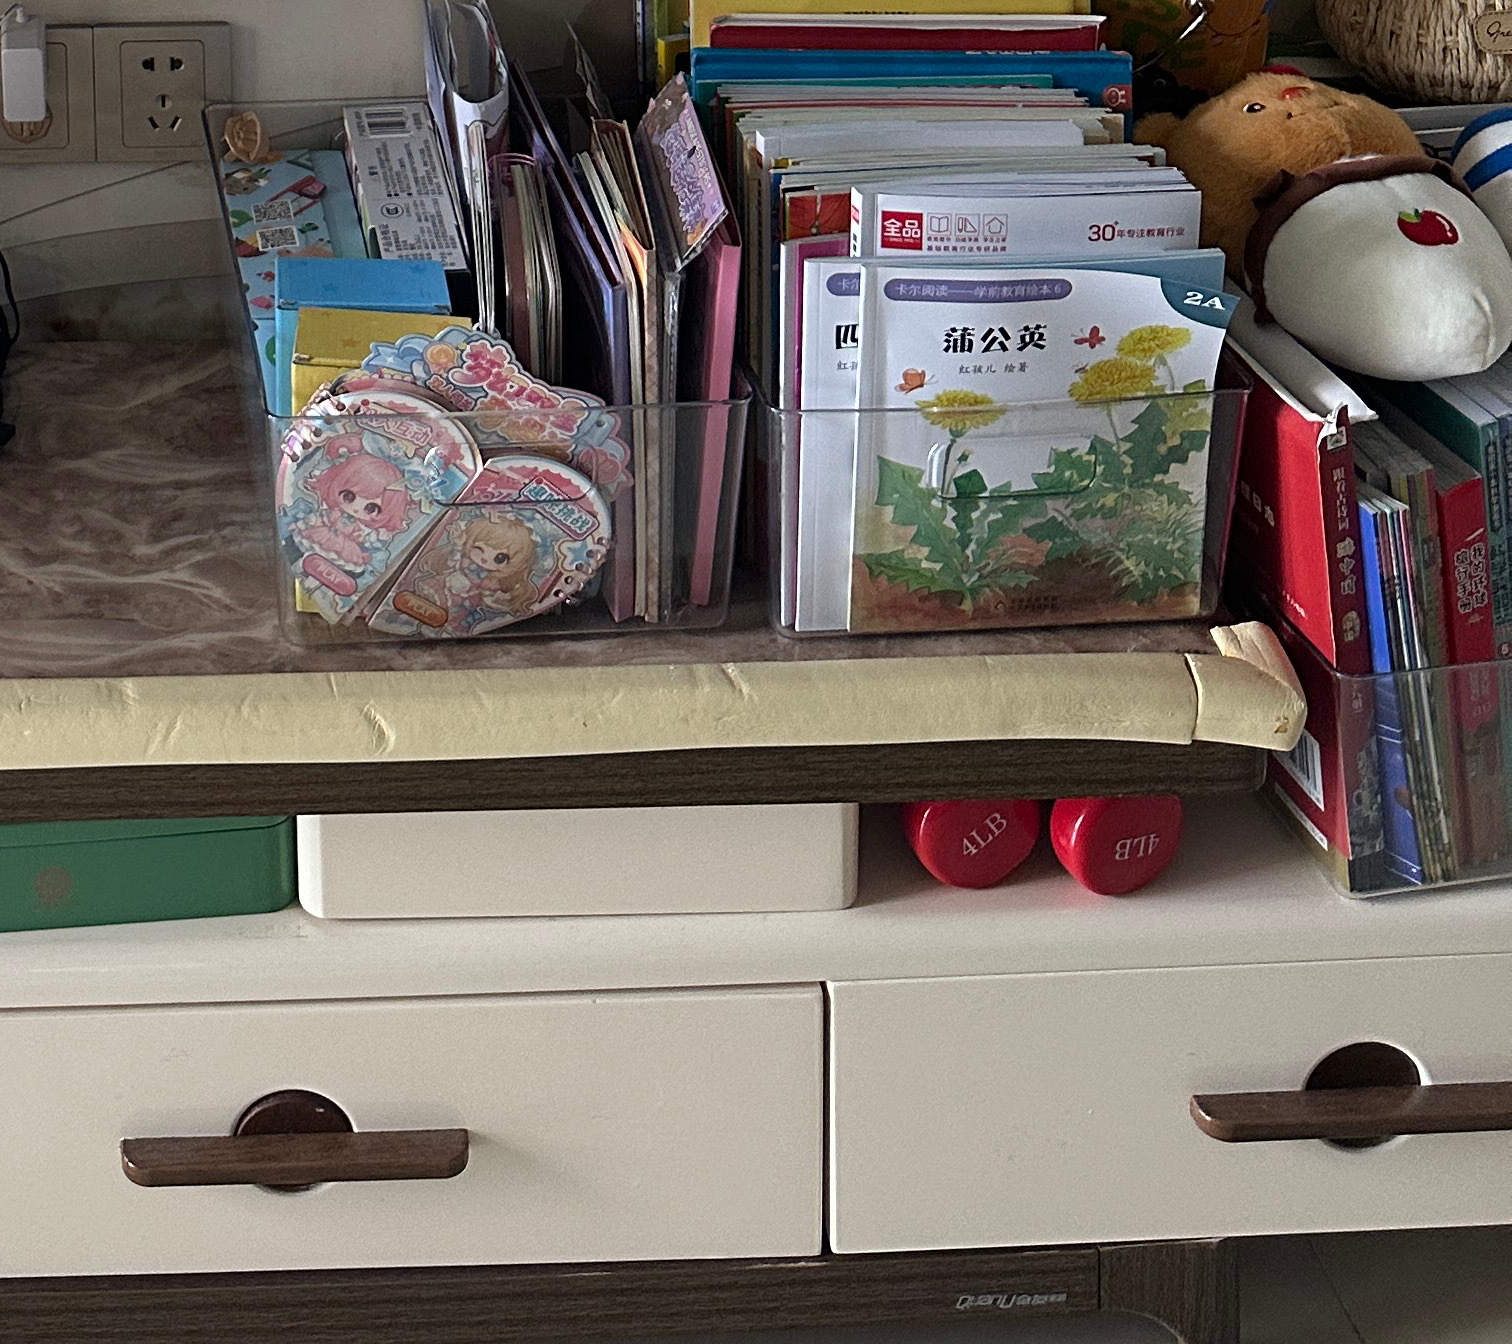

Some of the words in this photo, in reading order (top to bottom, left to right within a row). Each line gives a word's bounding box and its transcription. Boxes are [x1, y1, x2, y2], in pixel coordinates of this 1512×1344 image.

[883, 219, 921, 238] 全品
[1184, 291, 1226, 310] 2A
[943, 324, 1047, 353] 蒲公英
[1470, 543, 1488, 607] 我的环球
[962, 812, 1008, 857] 4LB
[1115, 833, 1161, 861] 4LB
